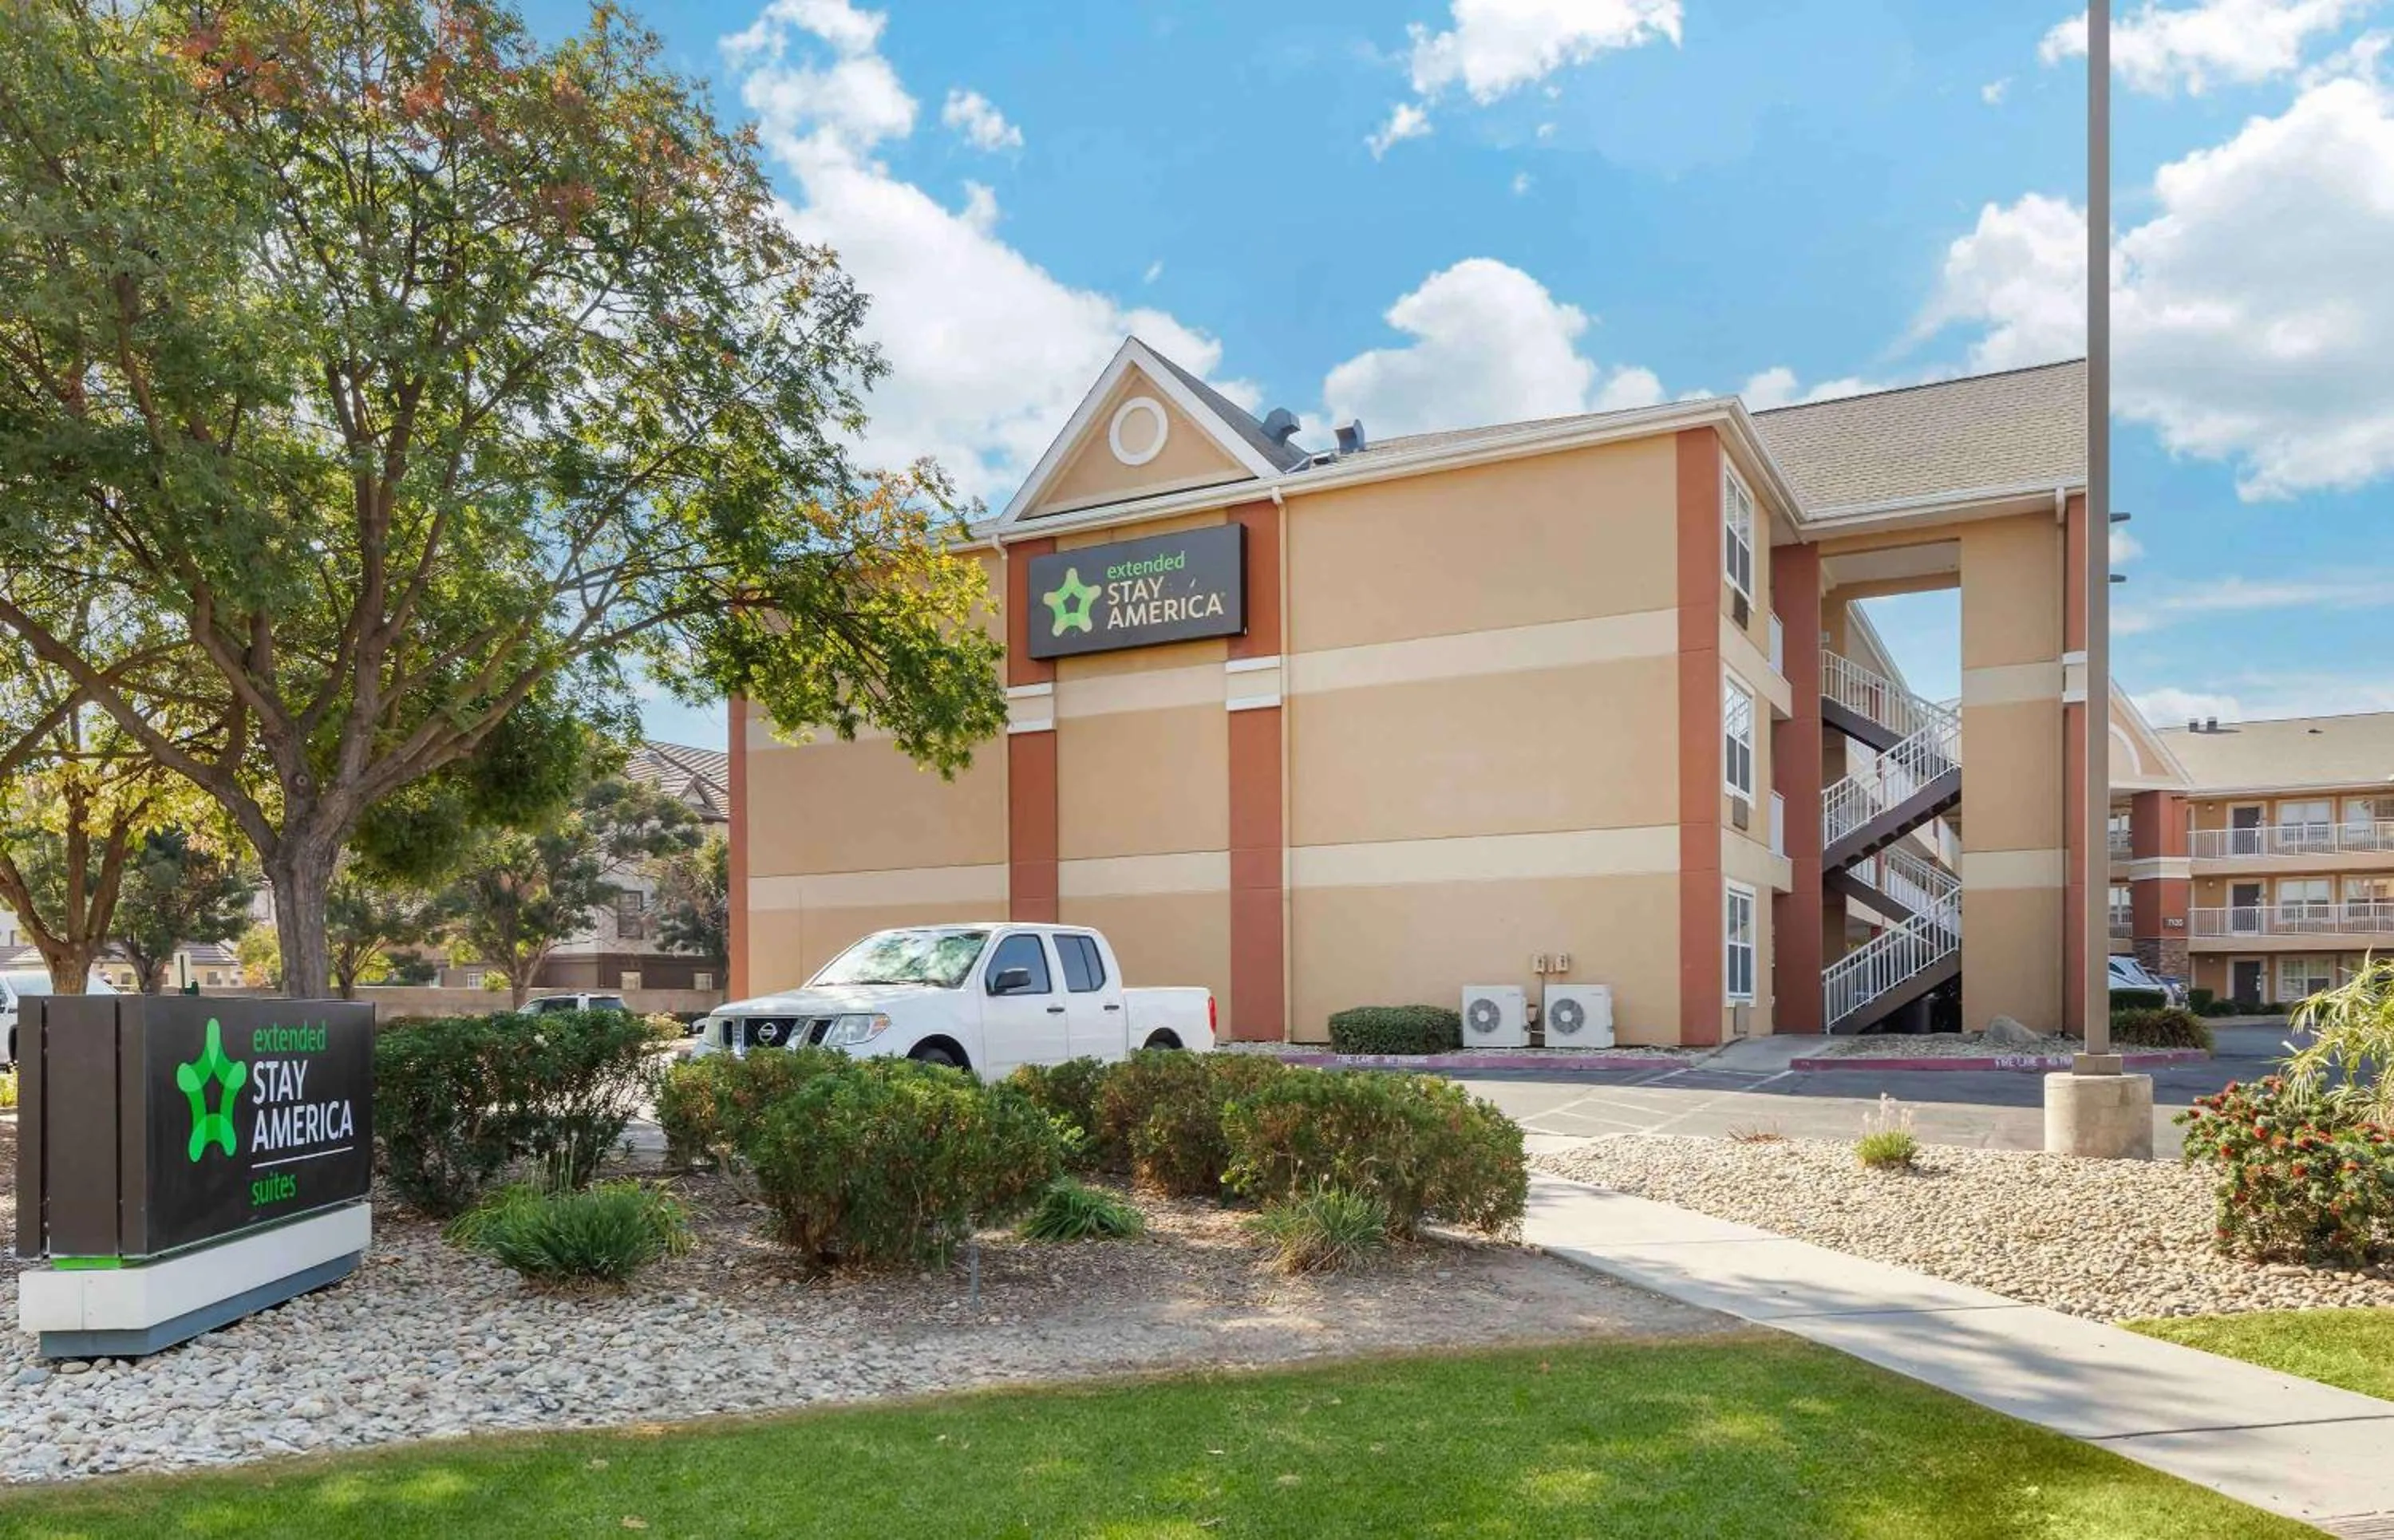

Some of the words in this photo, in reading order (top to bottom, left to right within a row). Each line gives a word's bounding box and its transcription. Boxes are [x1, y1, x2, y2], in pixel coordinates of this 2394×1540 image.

[1107, 551, 1185, 578] extended
[1108, 575, 1165, 606] STAY
[1107, 593, 1224, 630] AMERICA
[252, 1019, 326, 1052] extended
[252, 1059, 308, 1105] STAY
[251, 1099, 354, 1153] AMERICA
[251, 1171, 298, 1206] suites
